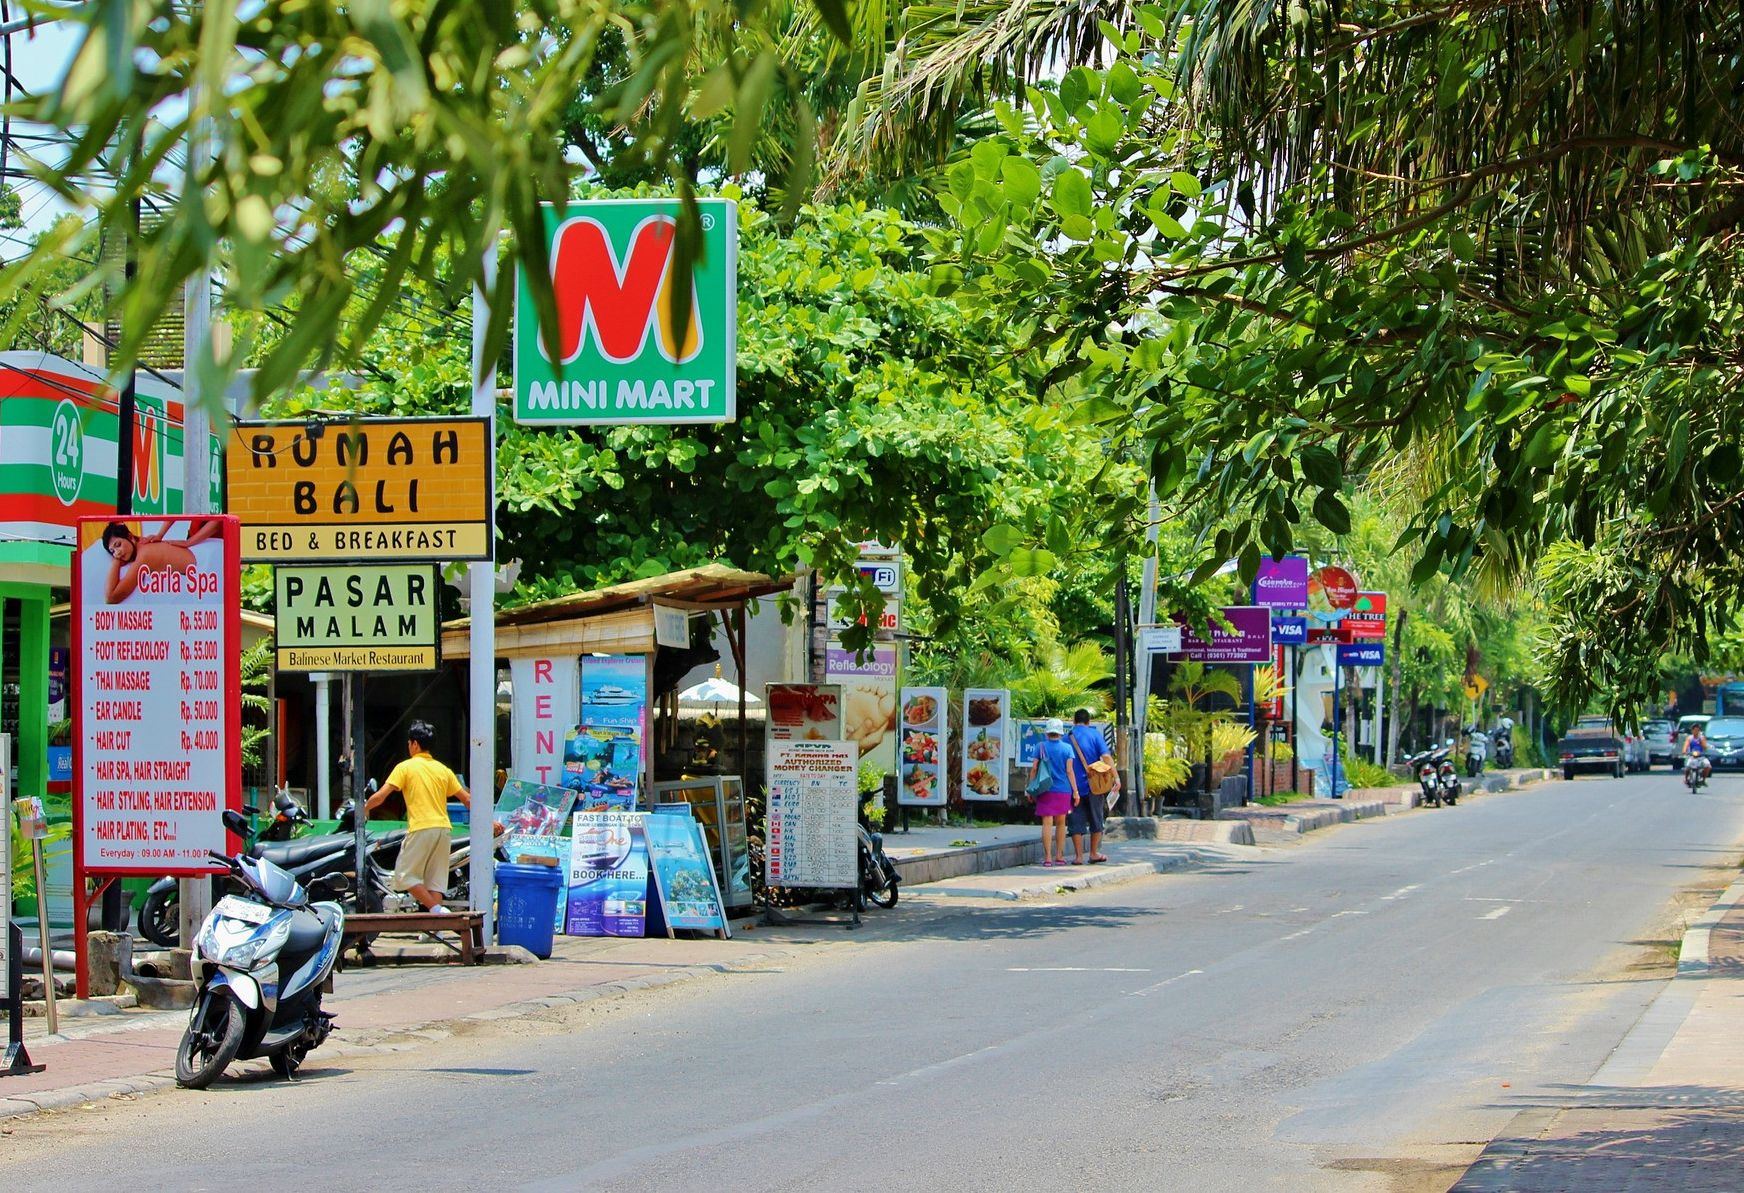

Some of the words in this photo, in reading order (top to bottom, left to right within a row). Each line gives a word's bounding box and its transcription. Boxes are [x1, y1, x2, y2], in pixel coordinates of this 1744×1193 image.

[528, 380, 607, 410] MINI
[615, 379, 715, 409] MART
[57, 415, 79, 469] 24
[251, 430, 459, 468] RUMAH
[57, 476, 77, 491] Hours
[293, 479, 419, 515] BALI
[256, 532, 293, 551] BED
[308, 532, 320, 550] &
[335, 529, 457, 550] BREAKFAST
[137, 564, 181, 594] Carla
[185, 564, 218, 599] Spa
[286, 574, 426, 608] PASAR
[95, 611, 115, 631] BODY
[117, 611, 152, 631] MASSAGE
[180, 611, 191, 635] Rp.
[193, 611, 217, 631] 55.000
[296, 614, 417, 638] MALAM
[1278, 625, 1303, 636] VISA
[95, 641, 115, 661] FOOT
[117, 641, 170, 661] REFLEXOLOGY
[180, 641, 191, 664] Rp.
[193, 641, 217, 661] 55.000
[289, 652, 331, 666] Balinese
[333, 651, 366, 666] Market
[369, 650, 424, 665] Restaurant
[1359, 650, 1381, 660] VISA
[96, 671, 113, 691] THAI
[115, 671, 150, 691] MASSAGE
[180, 671, 191, 695] Rp.
[194, 671, 217, 691] 70.000
[96, 701, 110, 721] EAR
[112, 701, 141, 721] CANDLE
[180, 701, 192, 725] Rp.
[194, 701, 218, 721] 50.000
[96, 731, 114, 751] HAIR
[116, 731, 131, 751] CUT
[181, 731, 192, 755] Rp.
[194, 731, 218, 751] 40.000
[97, 761, 114, 781] HAIR
[116, 761, 132, 784] SPA,
[134, 761, 151, 781] HAIR
[153, 761, 190, 781] STRAIGHT
[97, 791, 114, 811] HAIR
[118, 791, 152, 814] STYLING,
[154, 791, 172, 811] HAIR
[174, 791, 216, 811] EXTENSION
[97, 821, 115, 841] HAIR
[117, 821, 150, 844] PLATING,
[100, 848, 135, 859] Everyday
[141, 848, 161, 858] 09.00
[163, 848, 175, 858] AM
[182, 848, 201, 858] 11.00
[203, 848, 212, 858] P
[573, 870, 603, 880] BOOK
[607, 870, 645, 880] HERE...
